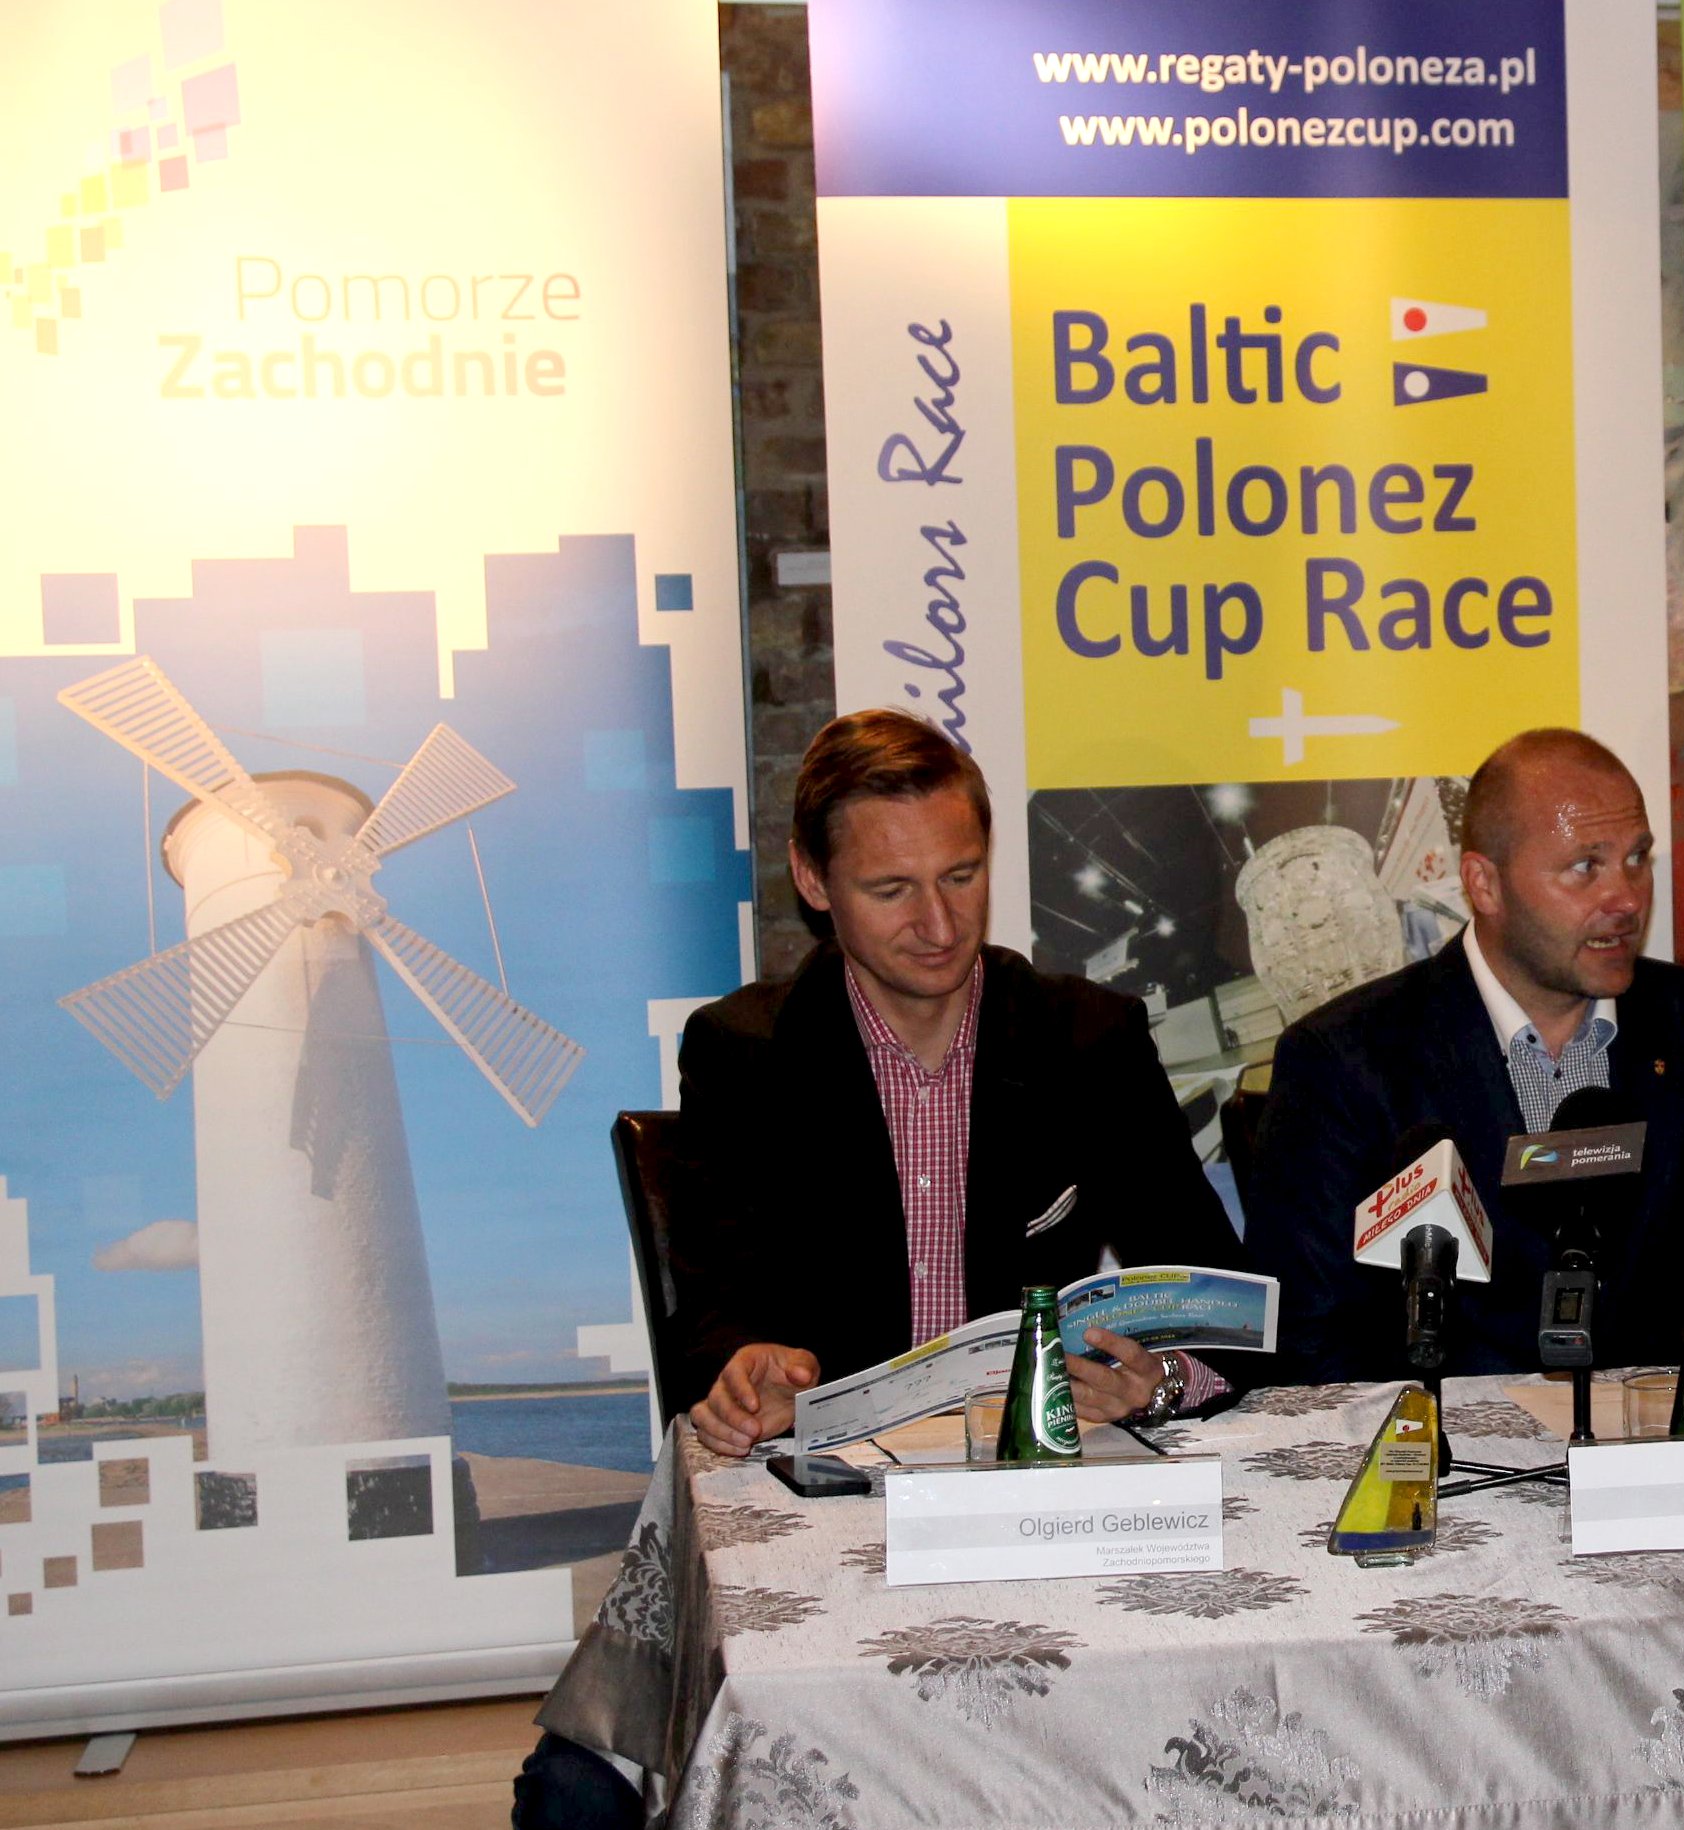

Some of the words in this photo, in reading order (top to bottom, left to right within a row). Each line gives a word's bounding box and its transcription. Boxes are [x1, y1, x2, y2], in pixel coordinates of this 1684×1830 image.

[1032, 46, 1536, 94] www.regaty-poloneza.pl
[1060, 108, 1515, 153] www.polonezcup.com
[233, 255, 582, 323] Pomorze
[157, 332, 567, 400] Zachodnie
[1052, 303, 1342, 407] Baltic
[878, 318, 966, 488] Race
[1055, 437, 1477, 541] Polonez
[1055, 560, 1264, 681] Cup
[1304, 557, 1553, 653] Race
[1570, 1151, 1632, 1168] pomerania
[1573, 1144, 1621, 1157] telewizja
[1406, 1184, 1432, 1210] DNIA
[1019, 1515, 1094, 1541] Olgierd
[1102, 1511, 1210, 1533] Geblewicz
